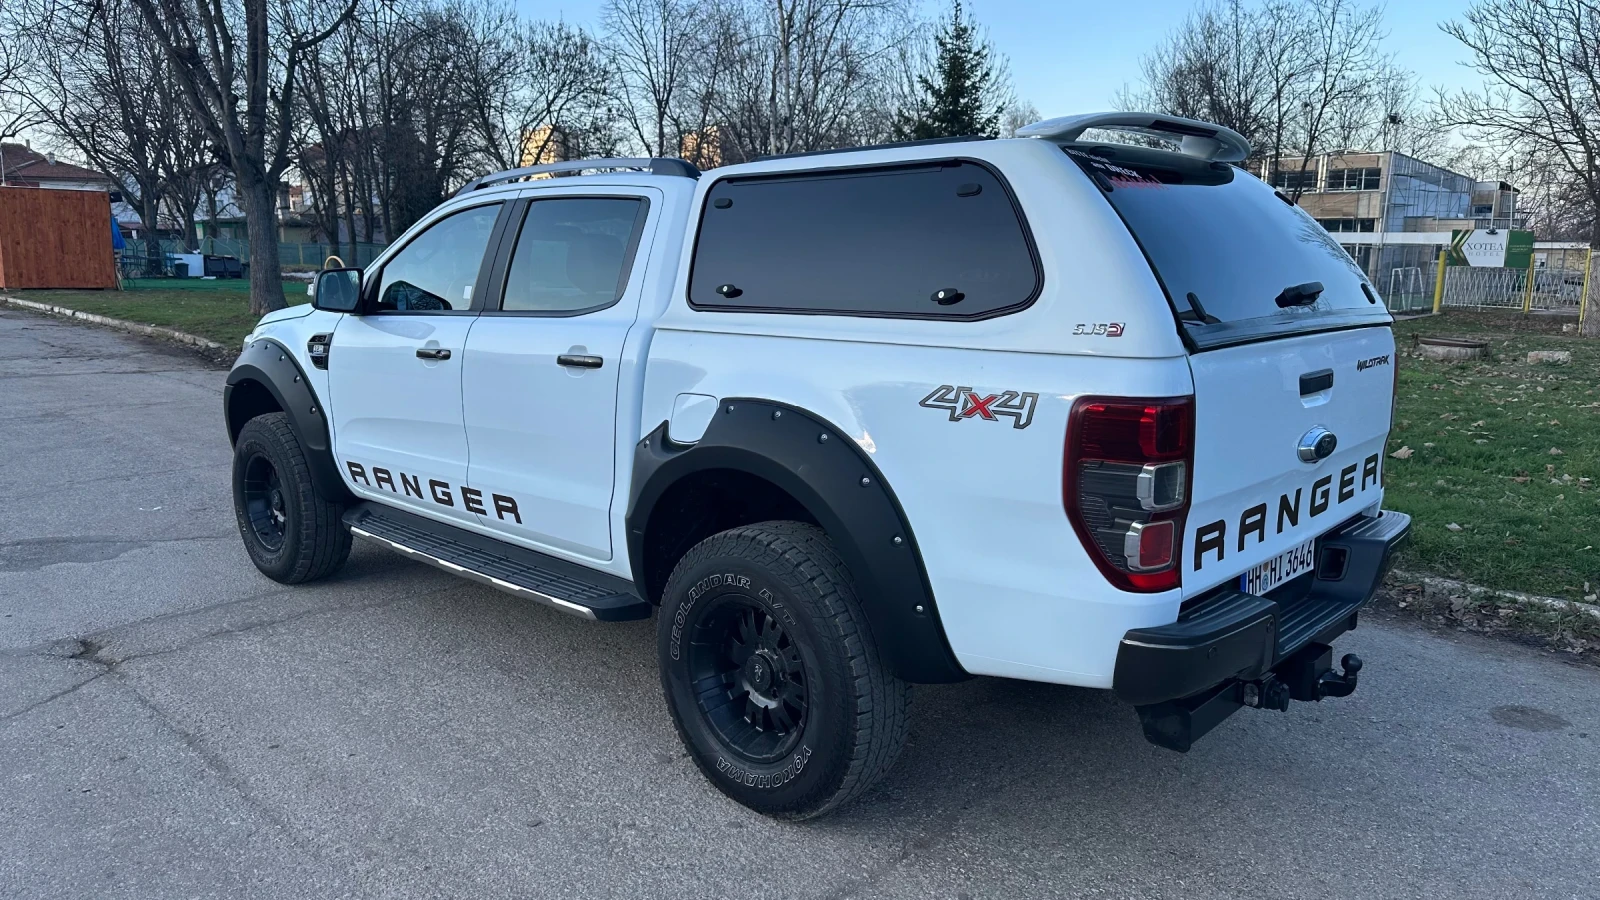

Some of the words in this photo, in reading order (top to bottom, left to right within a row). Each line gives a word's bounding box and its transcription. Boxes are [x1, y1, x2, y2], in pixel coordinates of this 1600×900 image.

[1466, 242, 1504, 251] ХОТЕЛ
[1357, 354, 1390, 372] WILDTRAK
[346, 460, 523, 525] RANGER
[1193, 453, 1379, 572] RANGER
[1247, 565, 1262, 595] HH
[1269, 555, 1283, 587] HI
[1285, 539, 1313, 578] 3646
[670, 573, 751, 660] GEOLANDAR
[758, 588, 797, 627] A/T
[716, 745, 812, 788] YOKOHAMA
